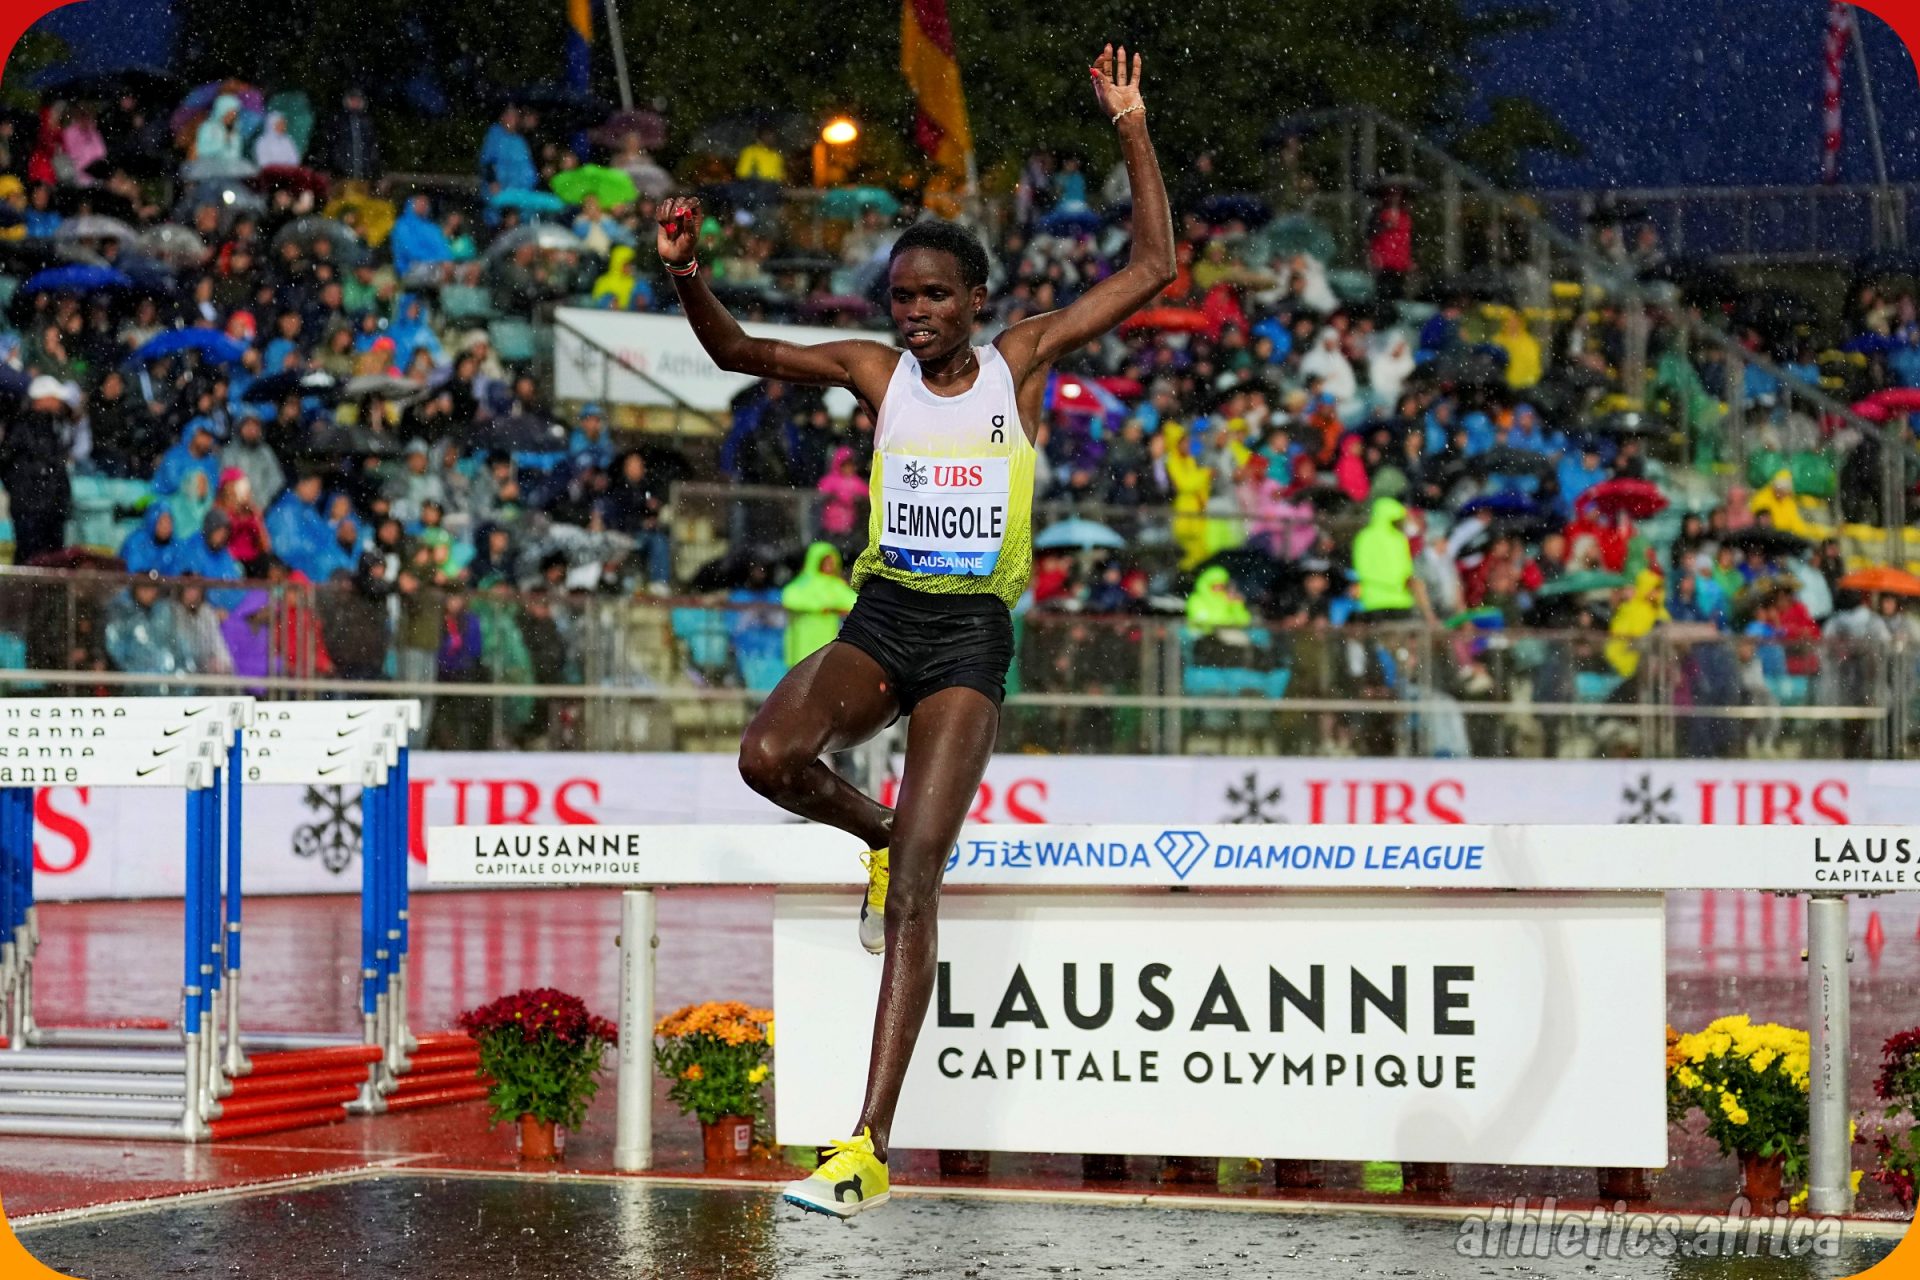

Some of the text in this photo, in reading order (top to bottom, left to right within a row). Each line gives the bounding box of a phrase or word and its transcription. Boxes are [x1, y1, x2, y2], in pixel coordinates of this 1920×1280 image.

[934, 465, 983, 487] UBS
[888, 501, 1002, 539] LEMNGOLE
[911, 555, 983, 568] LAUSANNE
[475, 834, 640, 857] LAUSANNE
[1035, 842, 1484, 870] WANDA DIAMOND LEAGUE
[1815, 837, 1920, 864] LAUS
[475, 862, 640, 874] CAPITALE OLYMPIQUE
[1815, 869, 1905, 882] CAPITALE
[936, 962, 1475, 1035] LAUSANNE
[938, 1047, 1476, 1089] CAPITALE OLYMPIQUE
